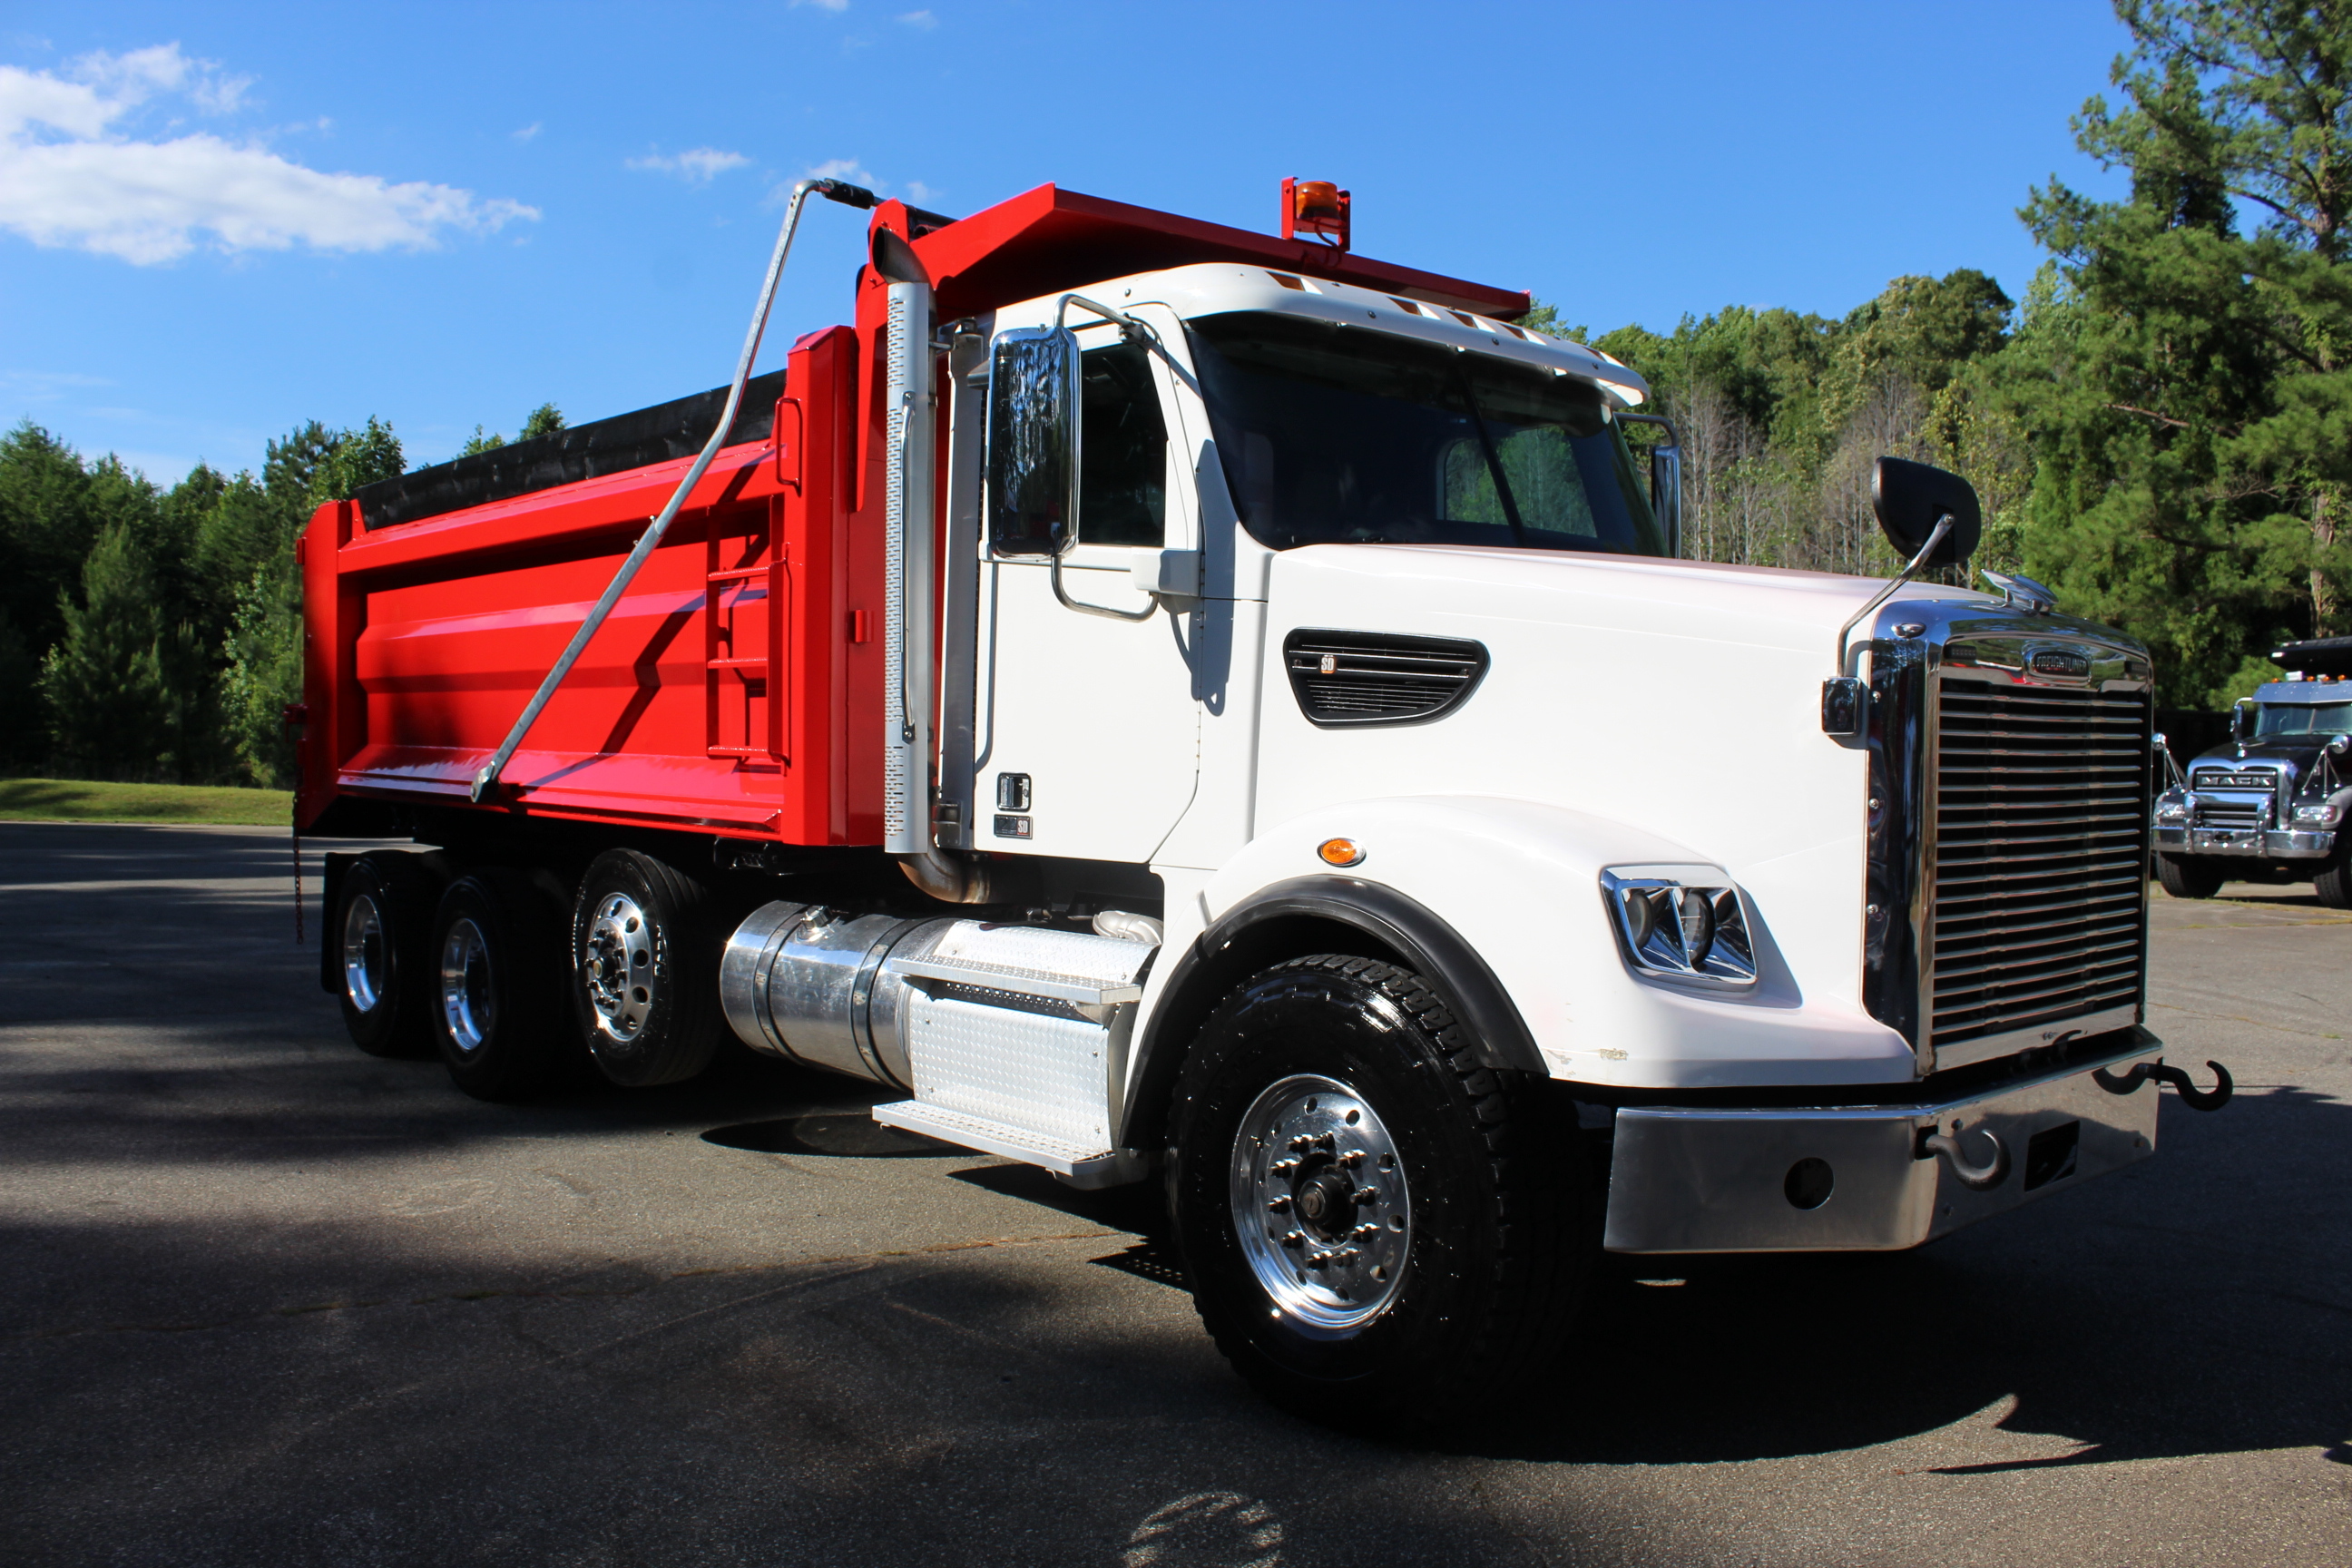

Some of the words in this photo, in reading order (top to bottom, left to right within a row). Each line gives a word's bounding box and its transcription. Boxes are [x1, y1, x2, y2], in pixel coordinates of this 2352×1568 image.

[1320, 657, 1335, 671] SD
[2037, 655, 2087, 671] FREIGHTLINER
[2200, 776, 2270, 786] MACK
